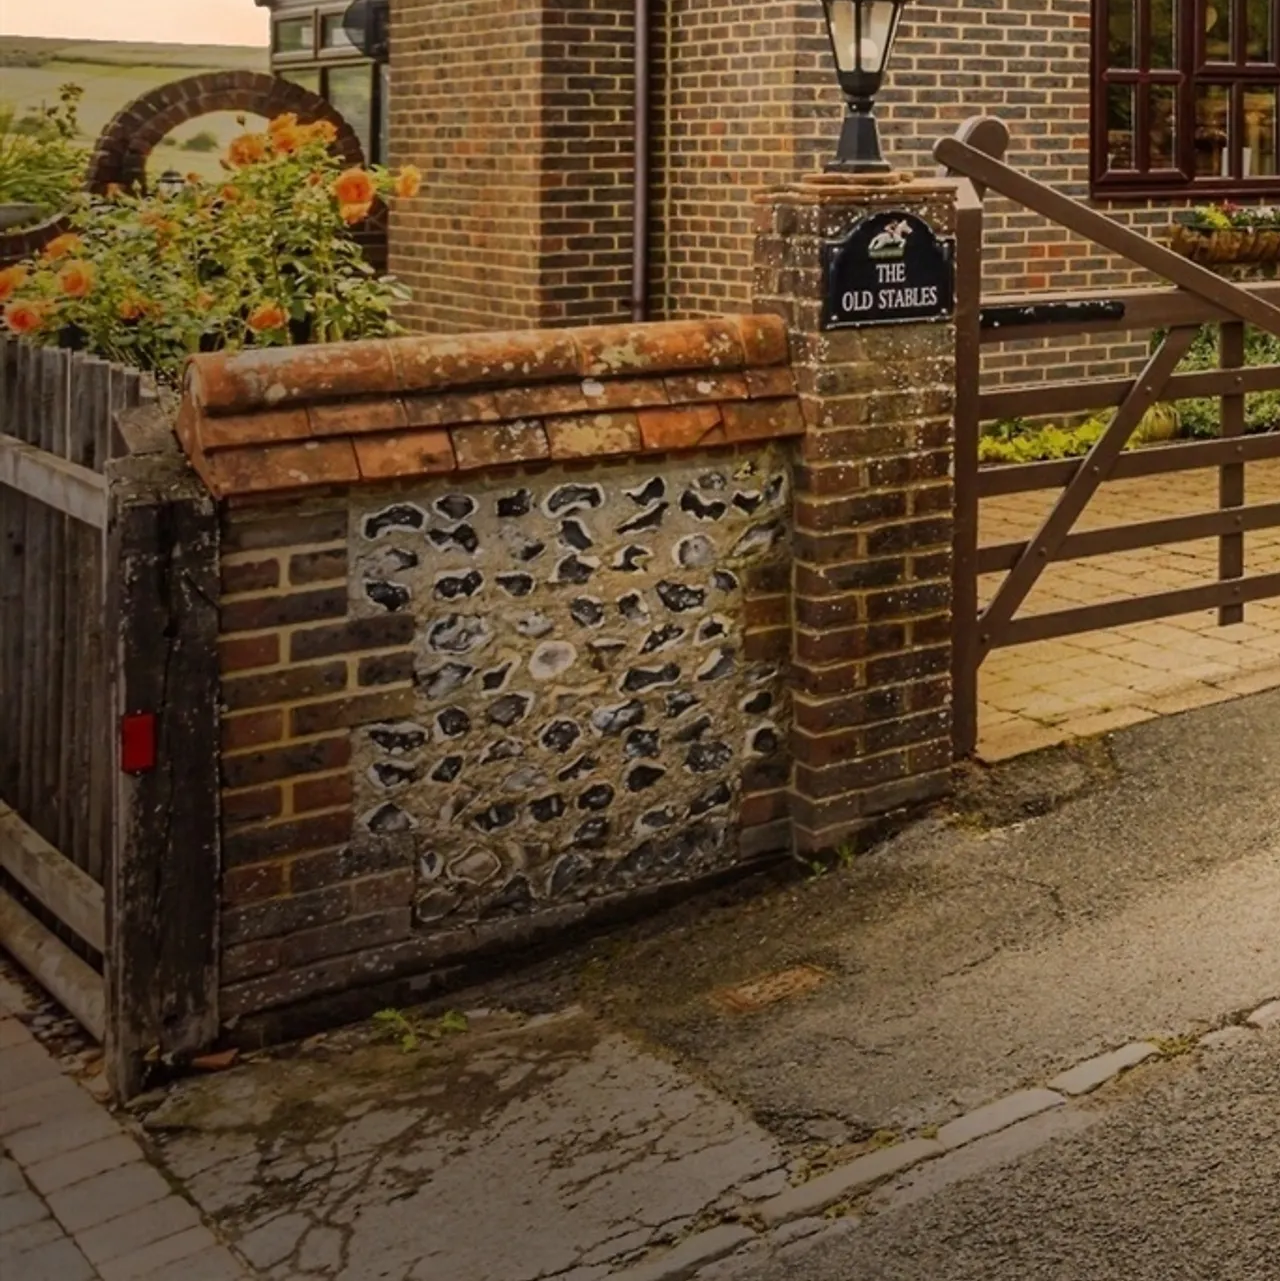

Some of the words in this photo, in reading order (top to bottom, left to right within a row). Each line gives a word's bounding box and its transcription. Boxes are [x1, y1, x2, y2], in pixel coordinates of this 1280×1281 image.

[876, 263, 906, 283] THE
[842, 291, 873, 312] OLD
[878, 286, 937, 309] STABLES
